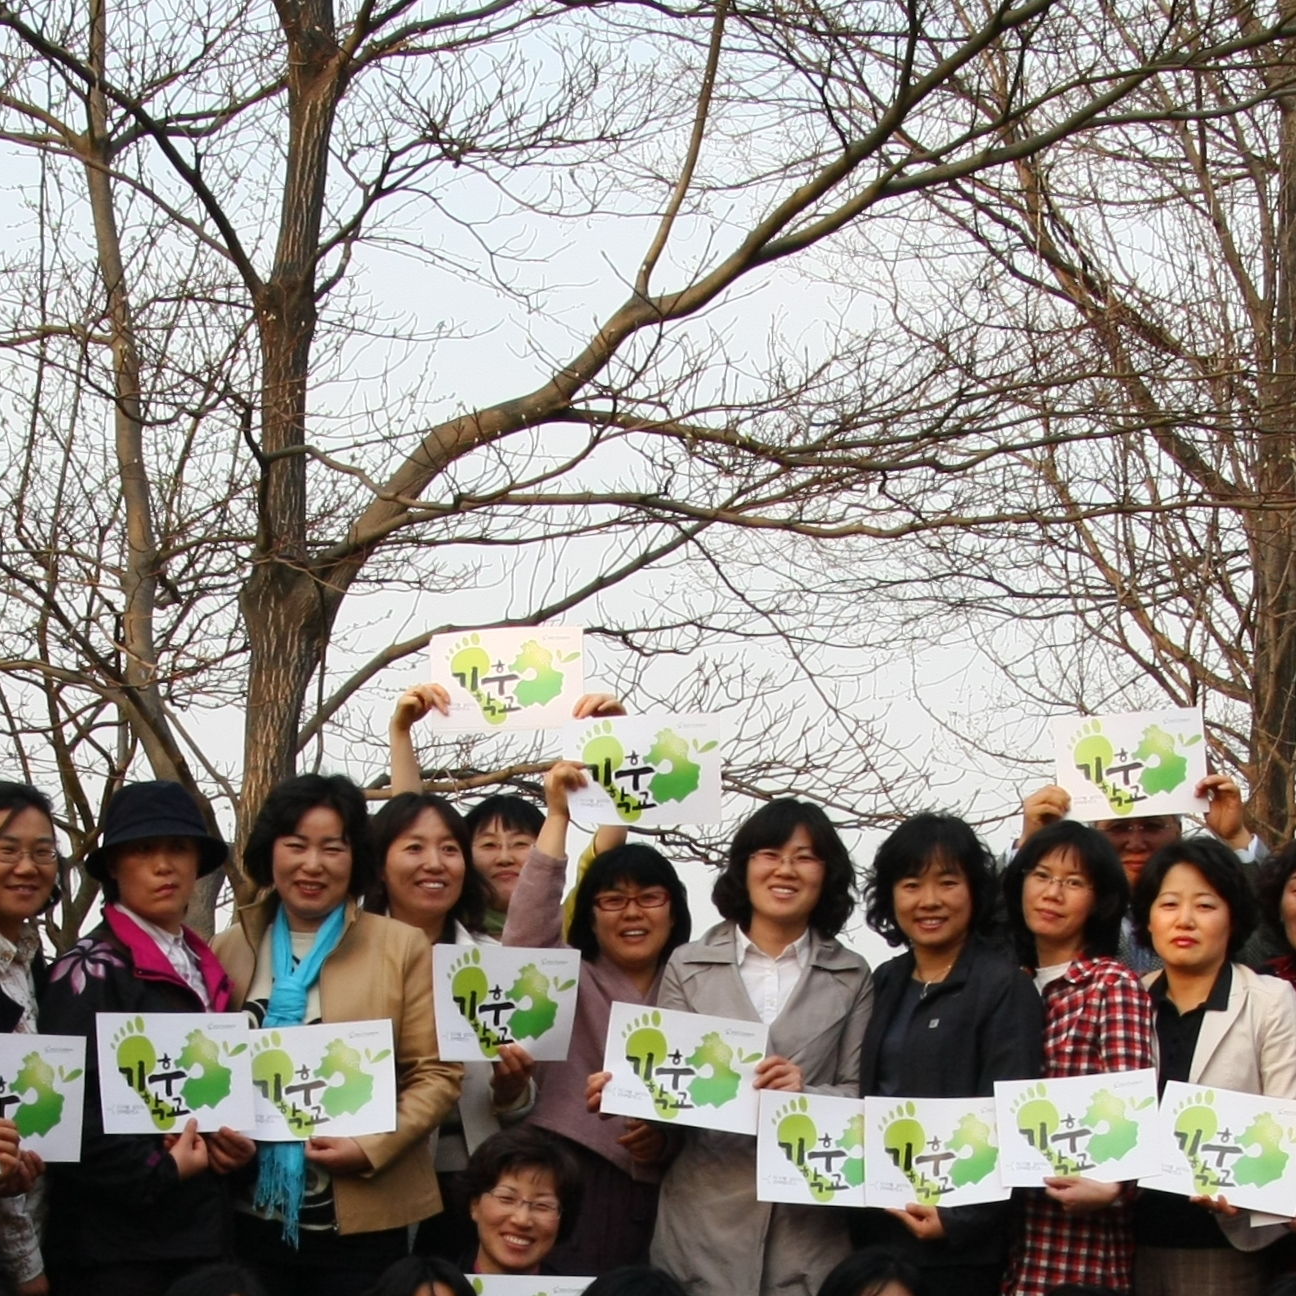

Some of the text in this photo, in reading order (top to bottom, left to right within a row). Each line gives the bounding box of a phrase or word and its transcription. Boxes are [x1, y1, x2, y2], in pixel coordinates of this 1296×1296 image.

[452, 659, 520, 695] 기후
[473, 689, 521, 715] 학교
[584, 751, 654, 791] 기후
[1075, 751, 1142, 787] 기후
[604, 784, 656, 816] 학교
[1098, 779, 1150, 804] 학교
[453, 984, 516, 1025] 기후
[119, 1053, 187, 1092] 기후
[625, 1049, 696, 1090] 기후
[144, 1092, 190, 1121] 학교
[646, 1079, 695, 1110] 학교
[276, 1100, 331, 1130] 학교
[1019, 1114, 1091, 1151] 기후
[778, 1133, 846, 1173] 기후
[885, 1135, 954, 1177] 기후
[1174, 1127, 1243, 1168] 기후
[800, 1167, 849, 1193] 학교
[907, 1170, 954, 1198] 학교
[1188, 1157, 1235, 1187] 학교
